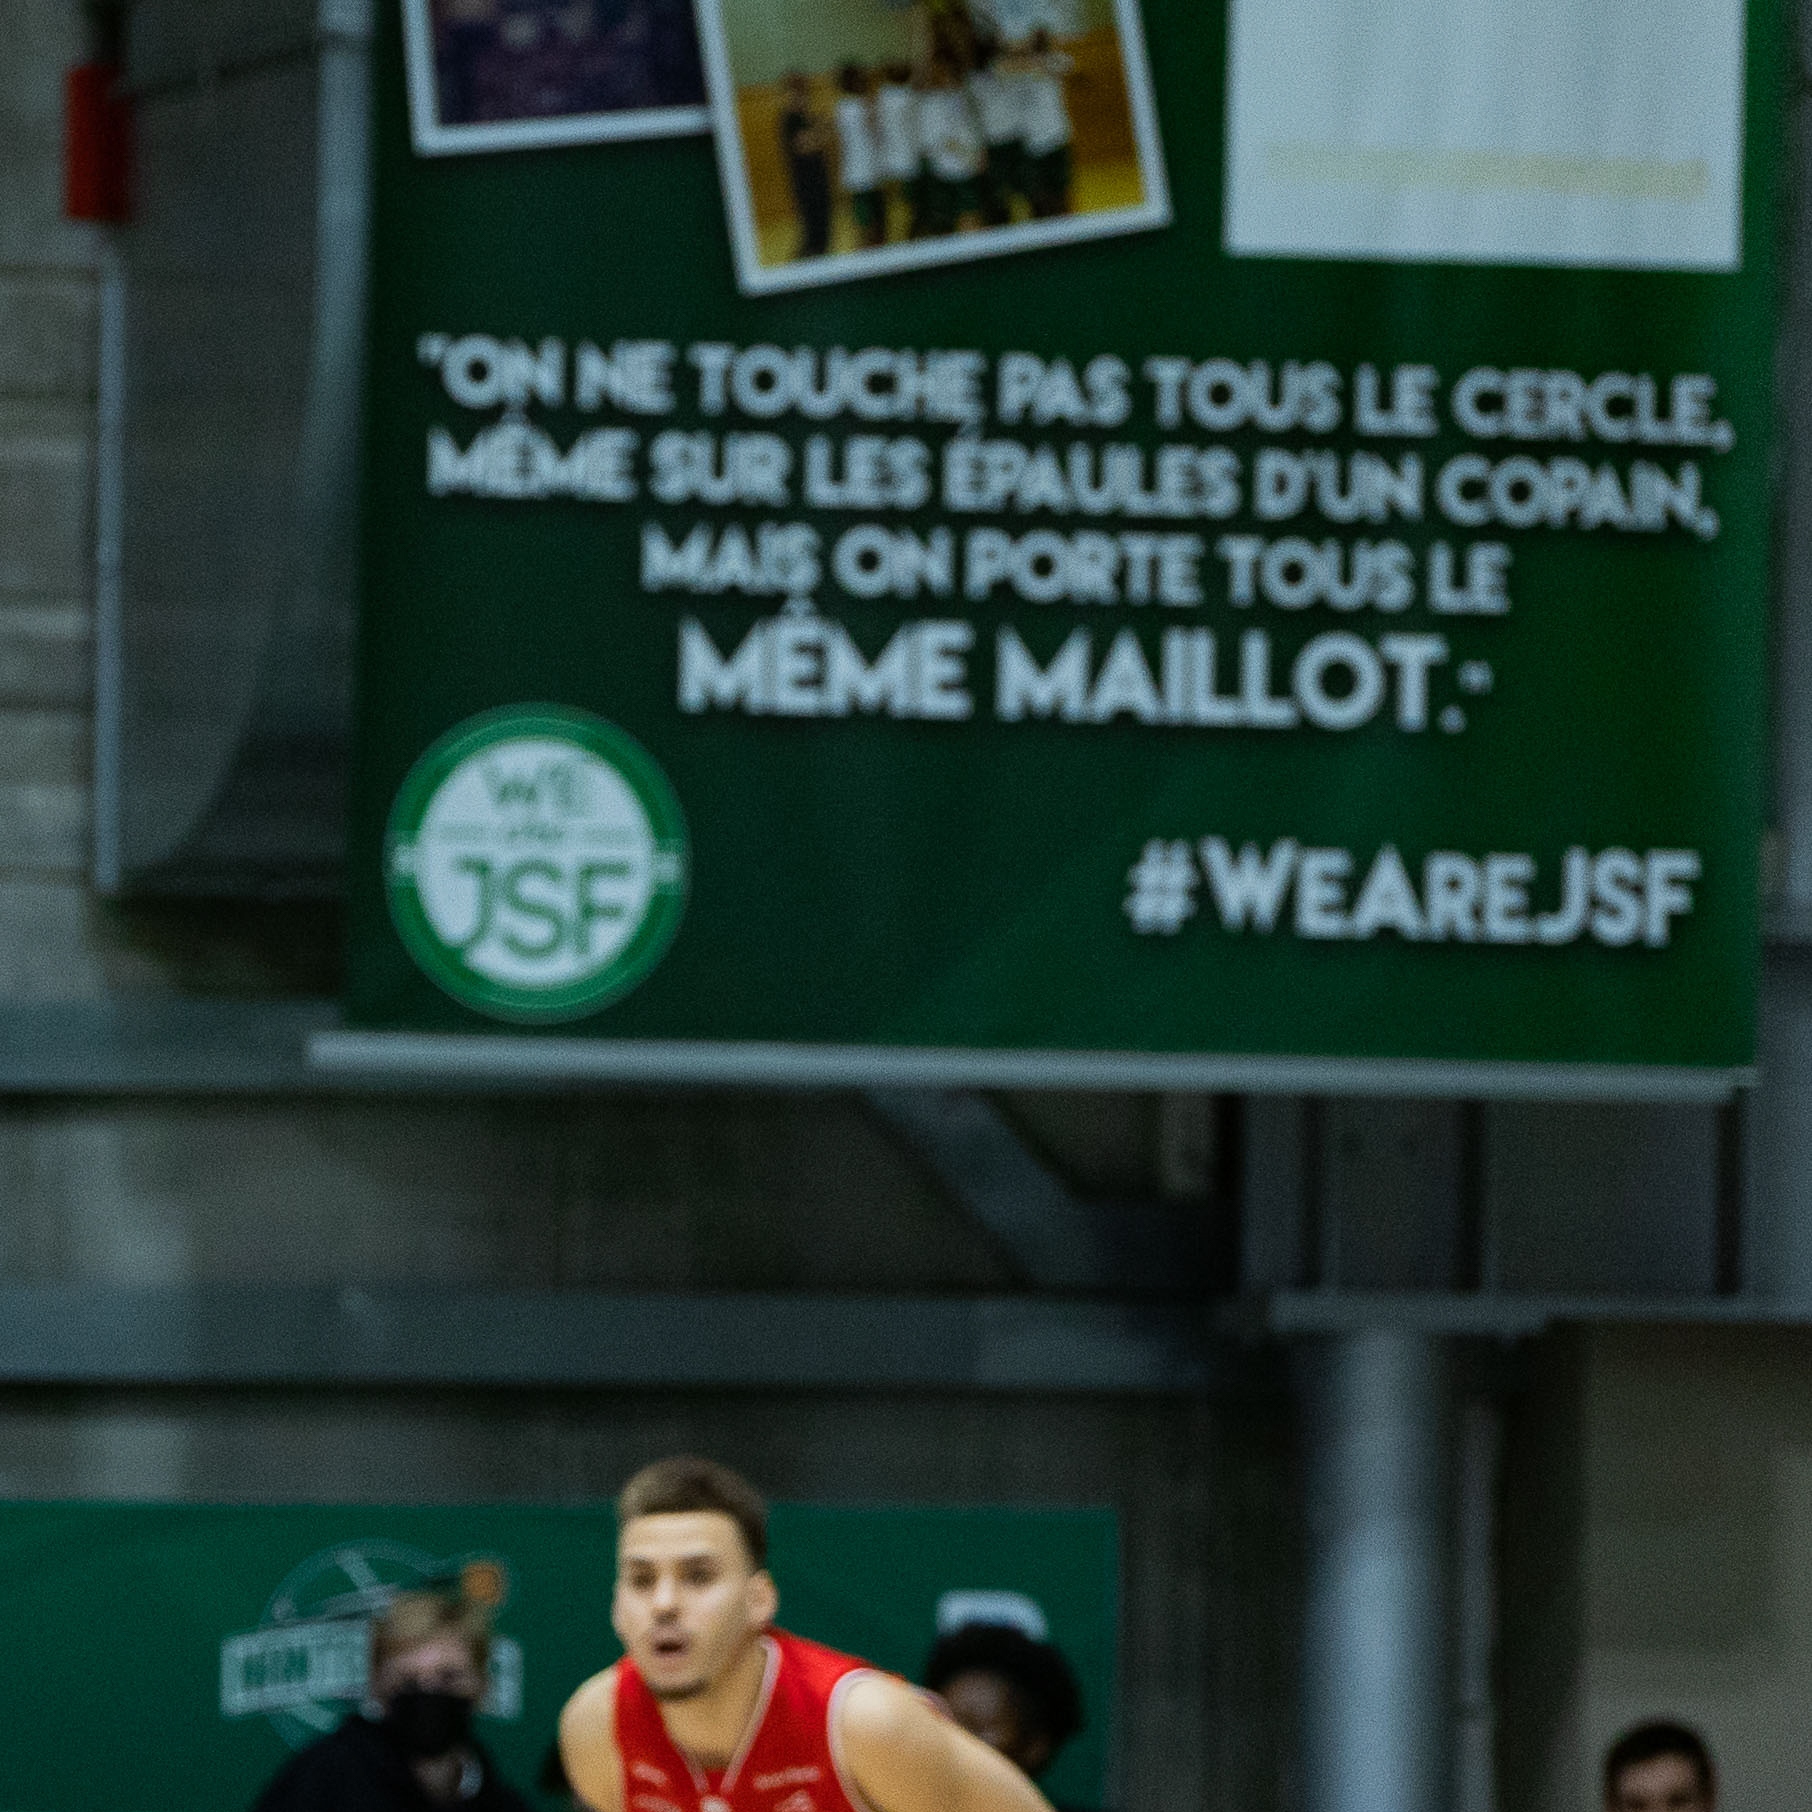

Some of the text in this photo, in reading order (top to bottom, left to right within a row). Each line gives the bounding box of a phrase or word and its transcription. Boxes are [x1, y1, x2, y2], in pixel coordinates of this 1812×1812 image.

[574, 339, 675, 415] NE
[687, 342, 987, 424] TOUCHE
[997, 350, 1132, 428] PAS
[1143, 355, 1345, 433] TOUS
[1352, 362, 1440, 438] LE
[1451, 366, 1736, 453] CERCLE,
[427, 408, 1721, 541] MÊME SUR LES ÉPAULES D'UN COPAIN,
[639, 520, 1513, 614] MAIS ON PORTE TOUS LE
[676, 596, 975, 720] MÊME
[452, 855, 632, 960] JSF
[1126, 836, 1704, 948] #WEAREJSF
